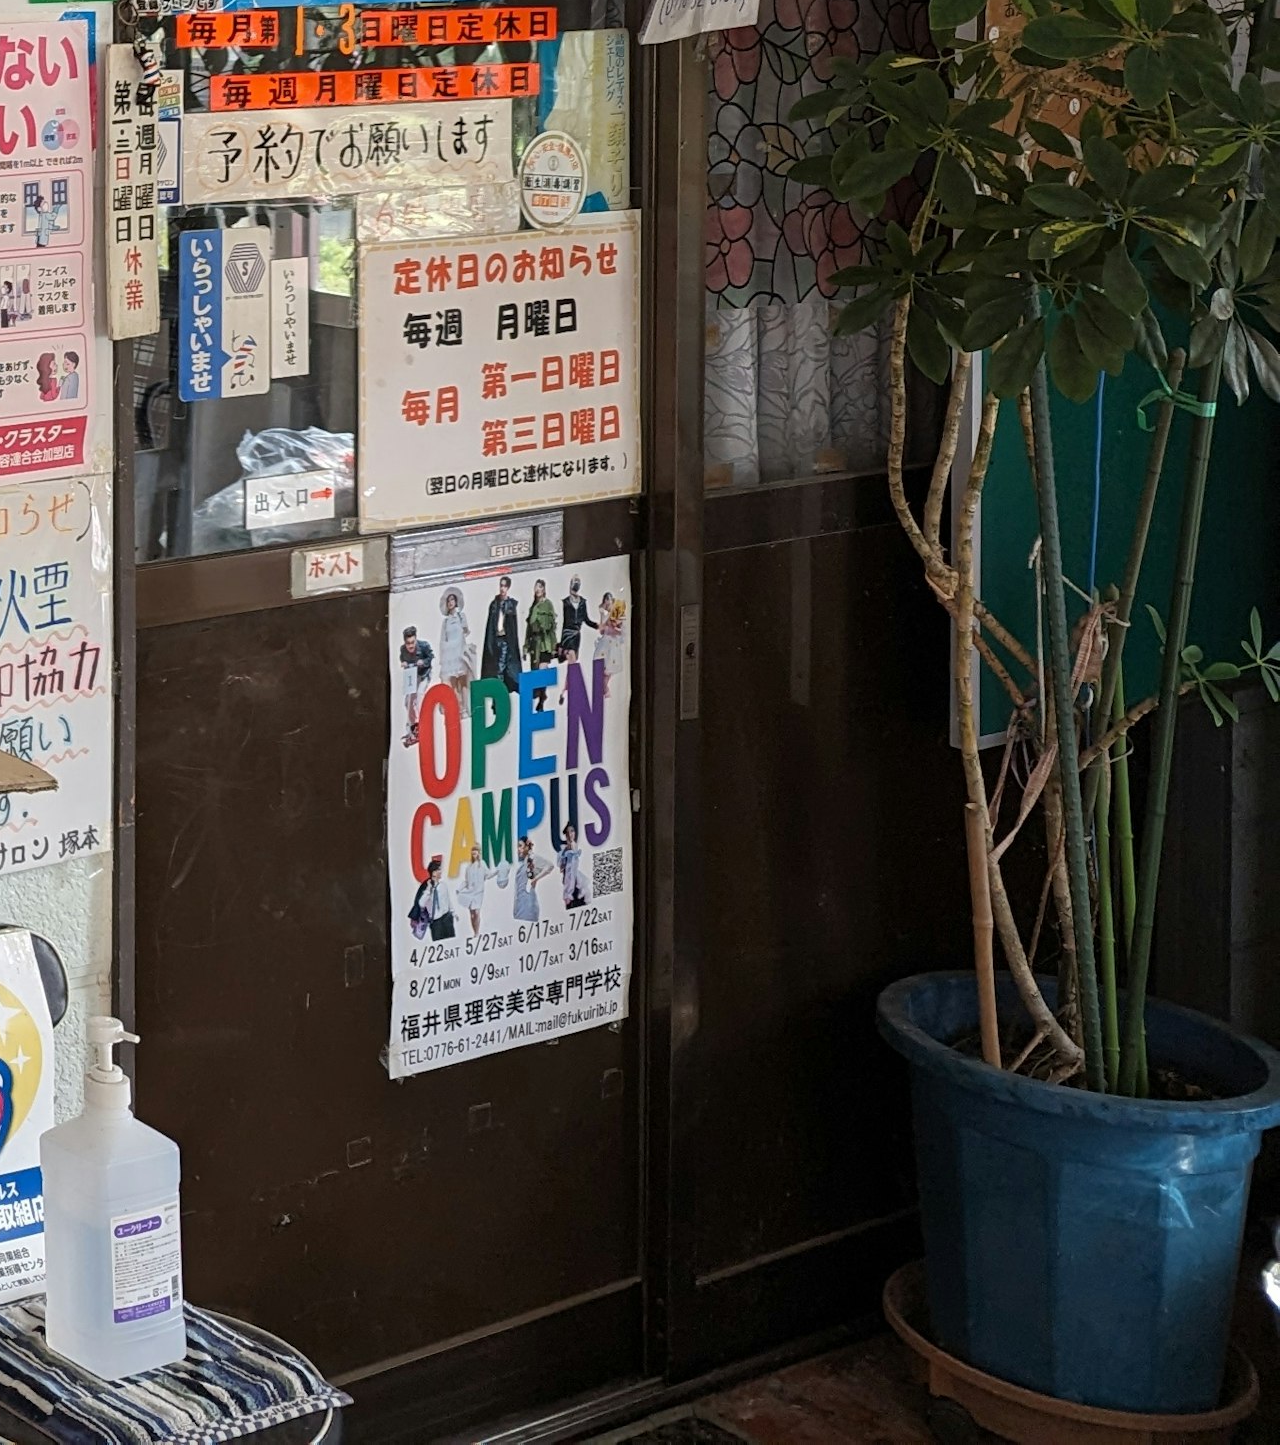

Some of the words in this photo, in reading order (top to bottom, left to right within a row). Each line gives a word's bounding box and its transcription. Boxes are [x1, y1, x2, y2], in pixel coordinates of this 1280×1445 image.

[220, 65, 532, 108] 毎週月曜日定休日
[606, 35, 615, 103] シェービング
[206, 114, 495, 184] 予約でお願いします
[37, 265, 69, 278] フェイス
[37, 277, 77, 290] シールドや
[123, 245, 145, 312] 休業
[392, 243, 619, 296] 定休日のお知らせ
[37, 290, 71, 302] マスクを
[37, 302, 78, 316] 着用します
[190, 237, 213, 394] いらっしゃいませ
[401, 309, 465, 350] 毎週
[495, 297, 579, 340] 月曜日
[480, 349, 622, 401] 第一日曜日
[400, 386, 460, 426] 毎月
[480, 405, 622, 459] 第三日曜日
[254, 486, 309, 514] 出入口
[307, 551, 360, 580] ポスト
[489, 541, 530, 557] LETTERS
[417, 657, 605, 801] OPEN
[410, 765, 611, 885] CAMPUS
[399, 964, 623, 1042] 福井県理容美容専門学校
[116, 1219, 160, 1236] ユークリーナー
